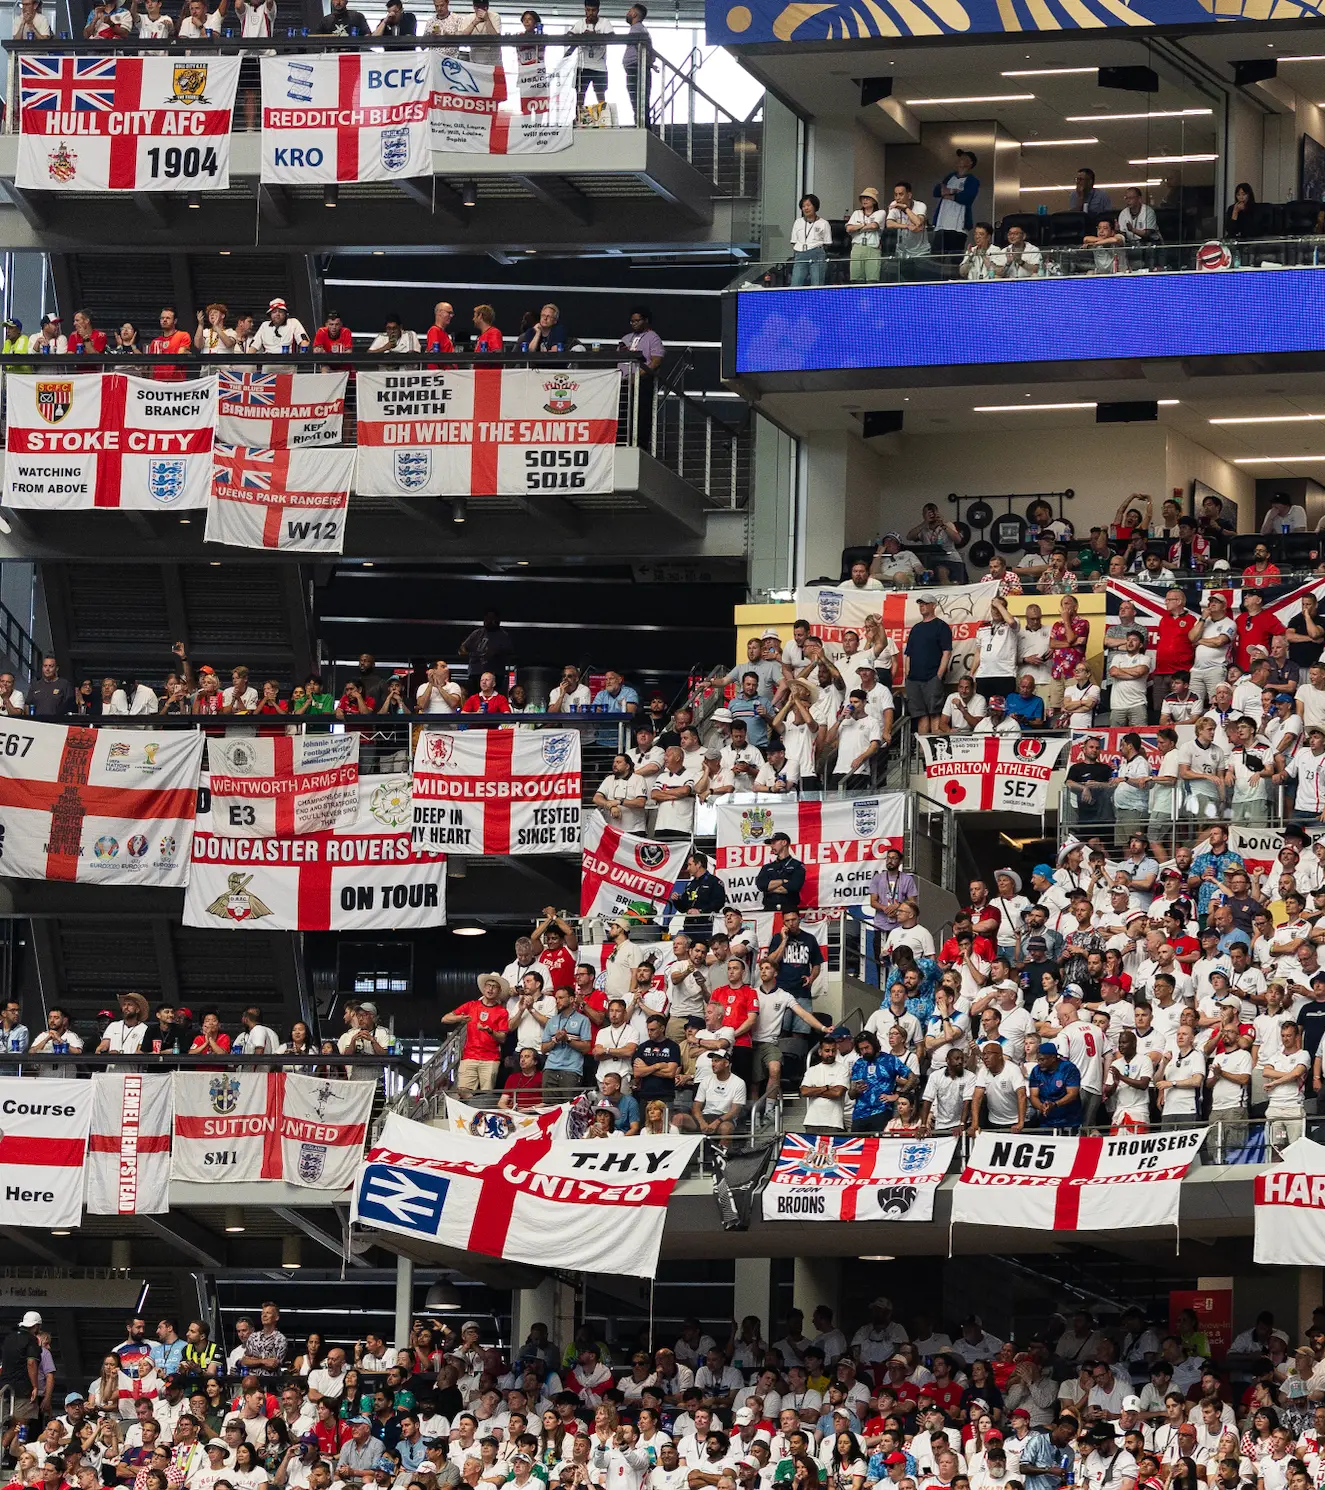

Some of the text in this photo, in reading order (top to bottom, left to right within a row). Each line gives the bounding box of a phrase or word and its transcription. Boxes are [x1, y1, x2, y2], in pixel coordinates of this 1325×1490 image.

[368, 66, 425, 89] BCFC
[45, 111, 206, 135] HULL CITY AFC
[269, 103, 424, 127] REDDITCH BLUES
[147, 147, 218, 178] 1904
[274, 148, 323, 167] KRO
[385, 376, 445, 388] DIPES
[136, 388, 210, 403] SOUTHERN
[377, 388, 452, 402] KIMBLE
[145, 404, 200, 416] BRANCH
[222, 403, 340, 418] BIRMINGHAM CITY
[383, 403, 445, 416] SMITH
[323, 431, 338, 440] ON
[383, 421, 590, 443] OH WHEN THE SAINTS
[27, 431, 195, 452] STOKE CITY
[18, 467, 82, 478] WATCHING
[12, 483, 88, 494] FROM ABOVE
[256, 492, 286, 503] PARK
[290, 495, 342, 505] RANGERS
[288, 521, 337, 540] W12
[303, 740, 329, 748] Johnnie
[65, 757, 87, 765] CALM
[60, 774, 87, 784] GET TO
[930, 763, 1048, 778] CHARLTON ATHLETIC
[1306, 770, 1314, 780] 23
[213, 768, 356, 795] WENTWORTH ARMS FC
[413, 778, 580, 797] MIDDLESBROUGH
[1003, 780, 1037, 798] SE7
[343, 789, 356, 798] MILE
[229, 805, 256, 826] E3
[320, 818, 337, 827] THAT
[321, 809, 343, 819] NEVER
[414, 807, 462, 825] DEEP IN
[533, 807, 579, 825] TESTED
[430, 828, 471, 845] HEART
[518, 827, 581, 845] SINCE 187
[43, 843, 84, 856] NEW YORK
[194, 836, 318, 862] DONCASTER
[326, 838, 409, 862] ROVERS
[857, 838, 891, 862] FC
[611, 867, 665, 897] UNITED
[728, 876, 758, 888] HAV
[835, 869, 882, 882] A CHEA
[341, 883, 438, 911] ON TOUR
[834, 886, 870, 898] HOLID
[783, 946, 809, 963] DALLAS
[1083, 1032, 1096, 1057] 9
[2, 1099, 76, 1117] Course
[204, 1118, 276, 1136] SUTTON
[119, 1078, 141, 1212] HEMEL HEMPSTEAD
[1108, 1133, 1198, 1156] TROWSERS
[204, 1150, 237, 1165] SM1
[571, 1150, 674, 1173] T.H.Y.
[989, 1141, 1056, 1170] NG5
[1137, 1156, 1158, 1169] FC
[503, 1163, 651, 1201] UNITED
[775, 1173, 870, 1186] READING
[970, 1165, 1186, 1186] NOTTS COUNTY
[6, 1185, 55, 1203] Here
[777, 1195, 825, 1214] BROONS
[618, 1466, 624, 1477] 9
